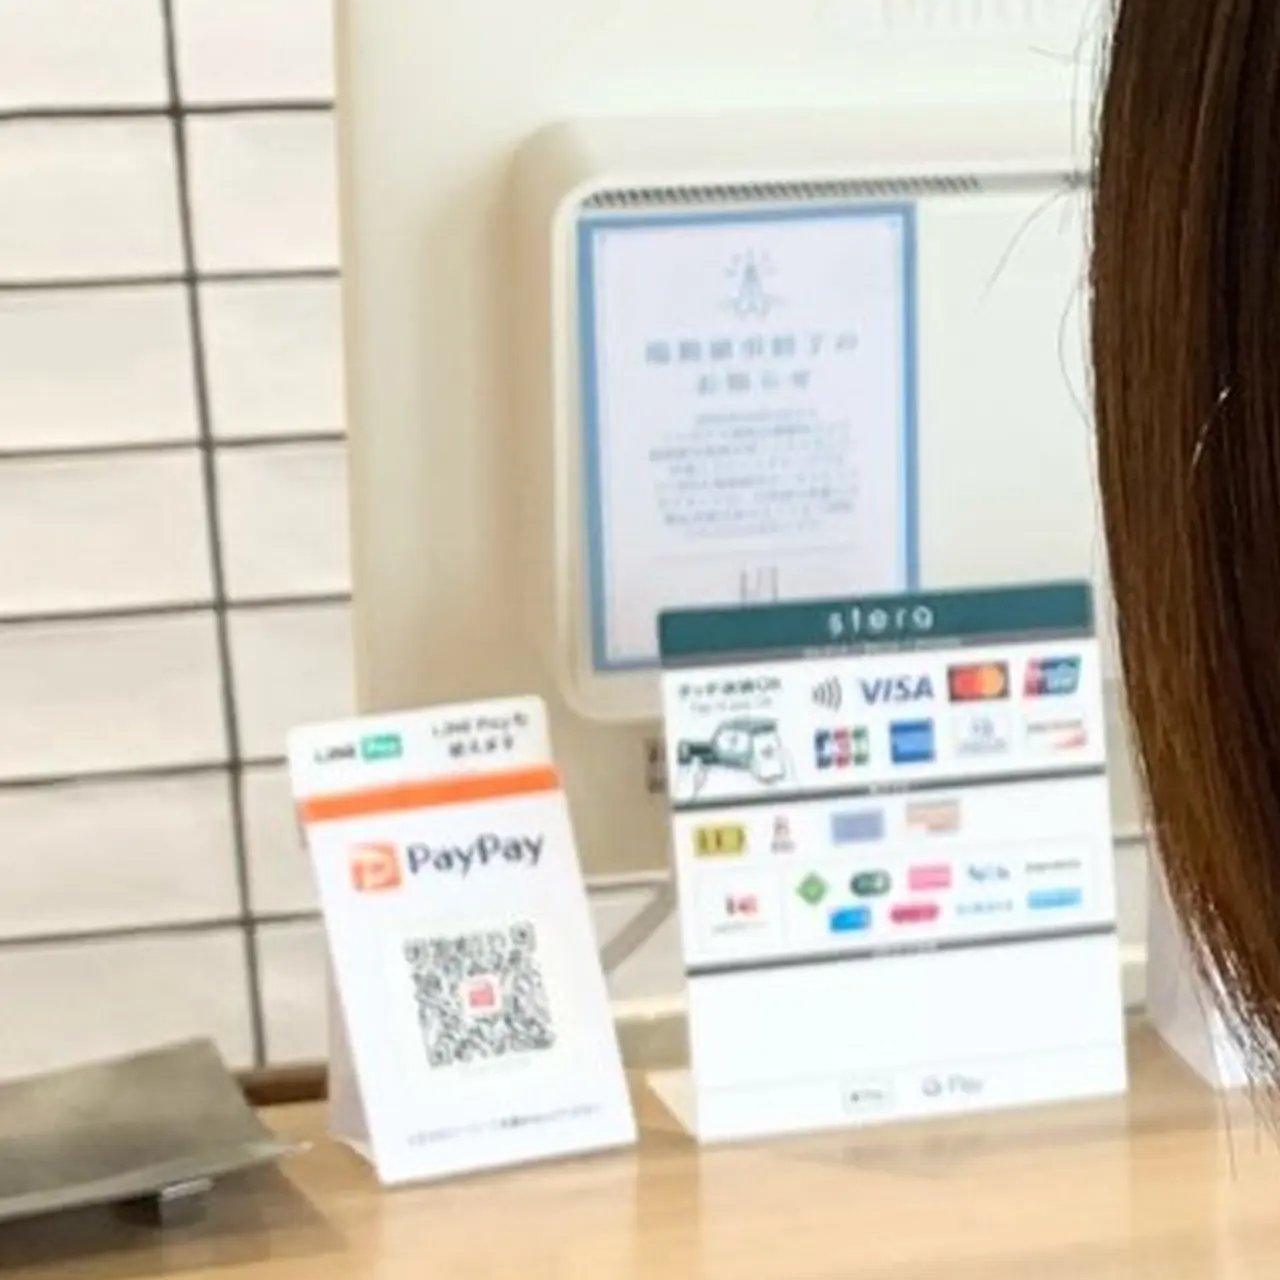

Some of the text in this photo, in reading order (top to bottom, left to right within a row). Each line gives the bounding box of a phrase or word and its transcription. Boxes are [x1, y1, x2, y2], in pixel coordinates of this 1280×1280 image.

[827, 604, 936, 638] stera
[857, 674, 935, 705] VISA
[405, 832, 547, 880] PayPay
